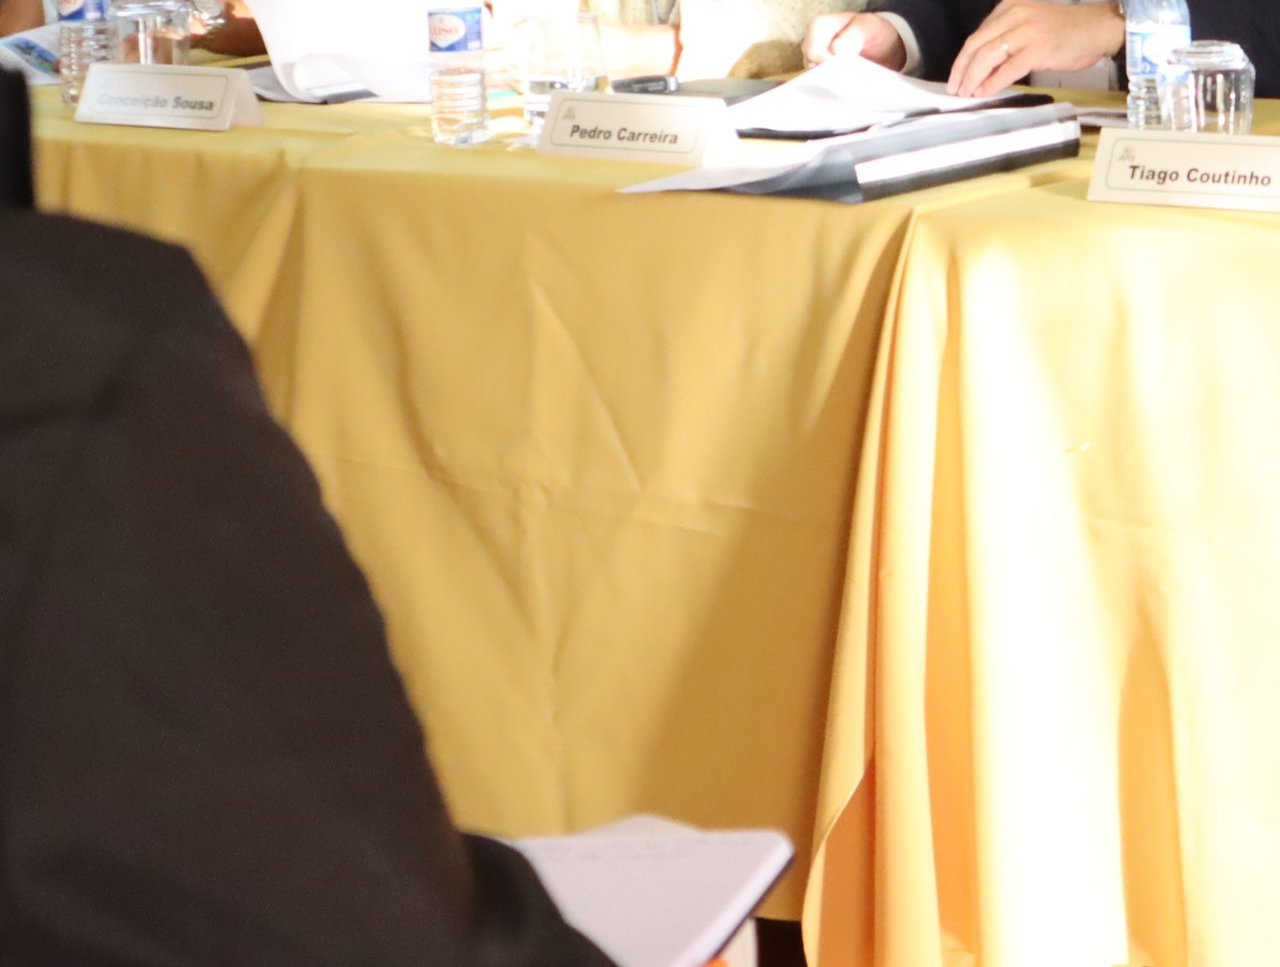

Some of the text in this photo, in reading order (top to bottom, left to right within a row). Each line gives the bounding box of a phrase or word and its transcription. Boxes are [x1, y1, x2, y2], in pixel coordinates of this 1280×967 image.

[172, 96, 214, 111] Sousa
[570, 124, 678, 144] Pedro Carreira
[1129, 165, 1272, 187] Tiago Coutinho
